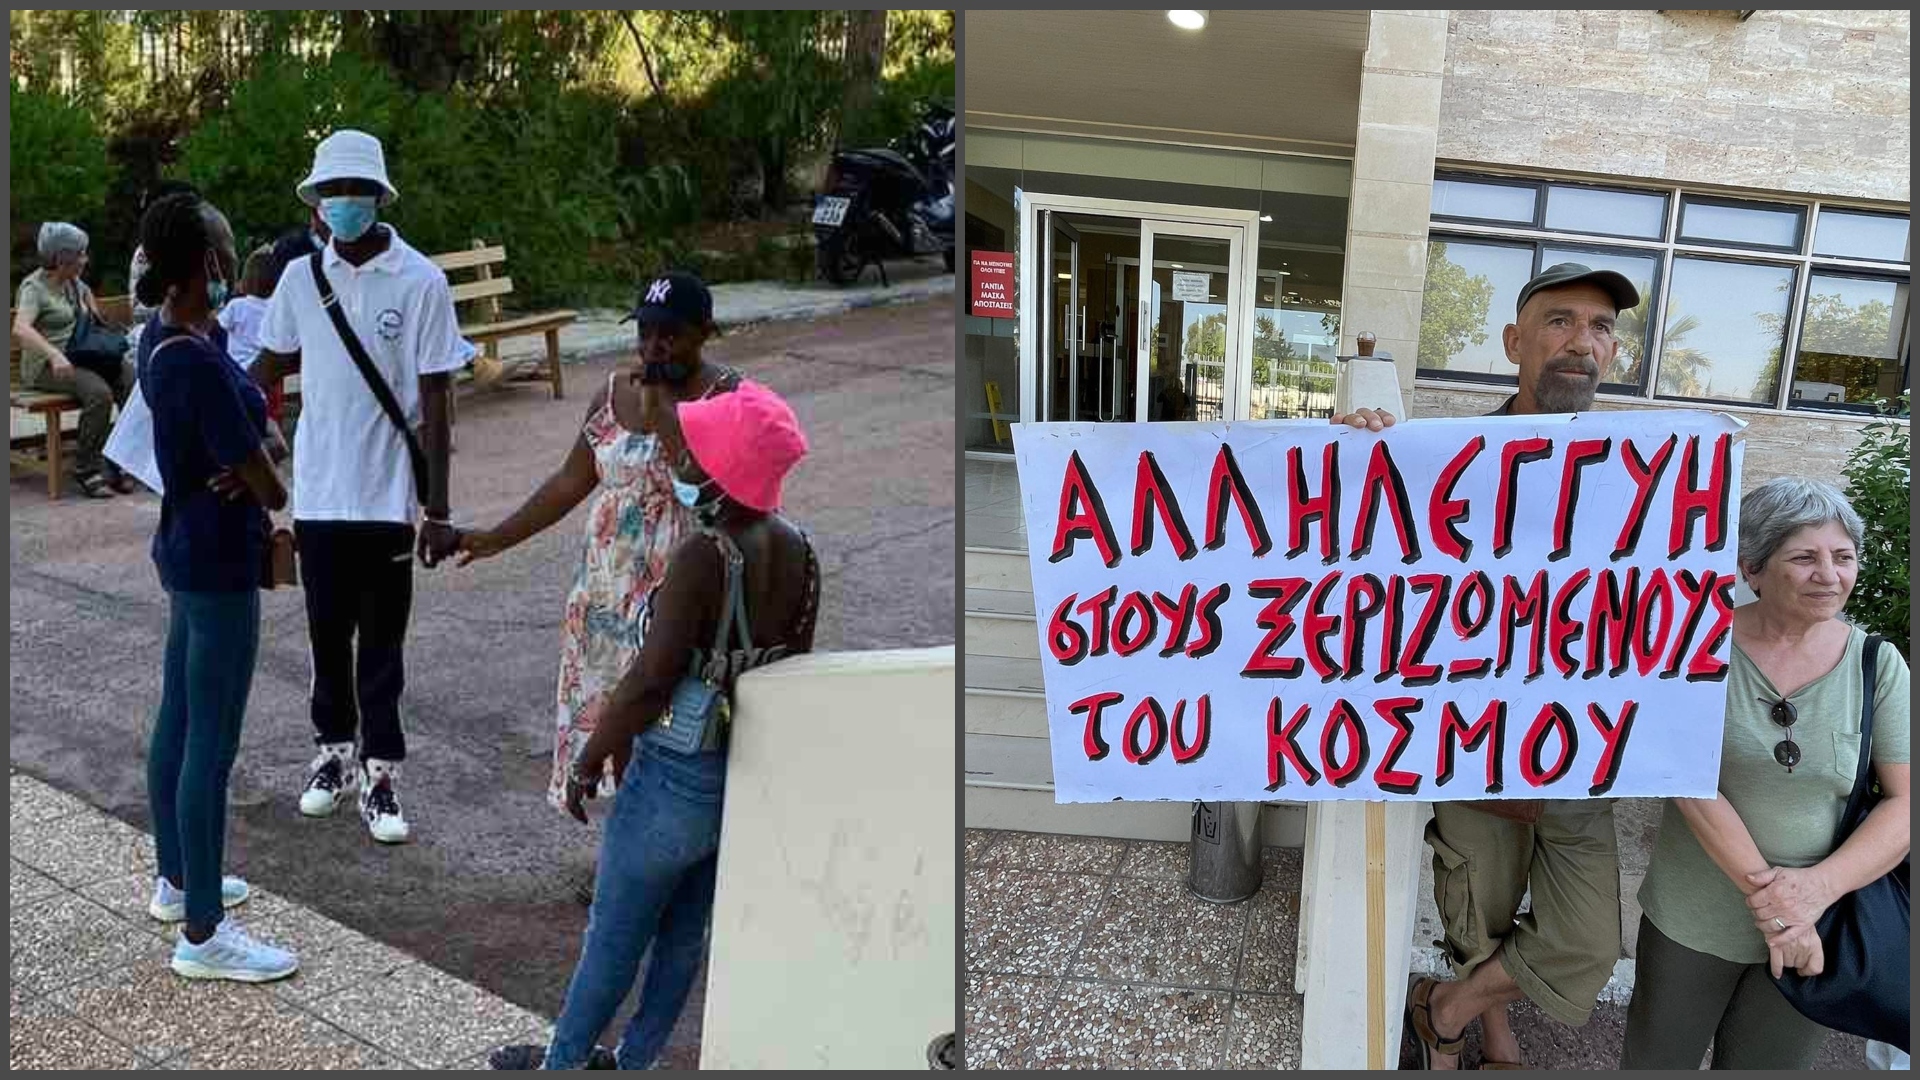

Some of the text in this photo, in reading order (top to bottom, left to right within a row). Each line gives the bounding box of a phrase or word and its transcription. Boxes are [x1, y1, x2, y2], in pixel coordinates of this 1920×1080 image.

[974, 300, 1013, 310] ΑΠΟΣΤΑΣΕΙΣ
[981, 282, 1005, 290] ΓΑΝΤΙΑ
[981, 291, 1005, 300] ΜΑΣΚΑ
[1048, 432, 1733, 568] ΑΛΛΗΛΕΓΓΥΗ
[1239, 566, 1737, 688] ΞΕΡΙΖΩΜΕΝΟΥΣ
[1264, 695, 1640, 797] ΚΟΣΜΟΥ
